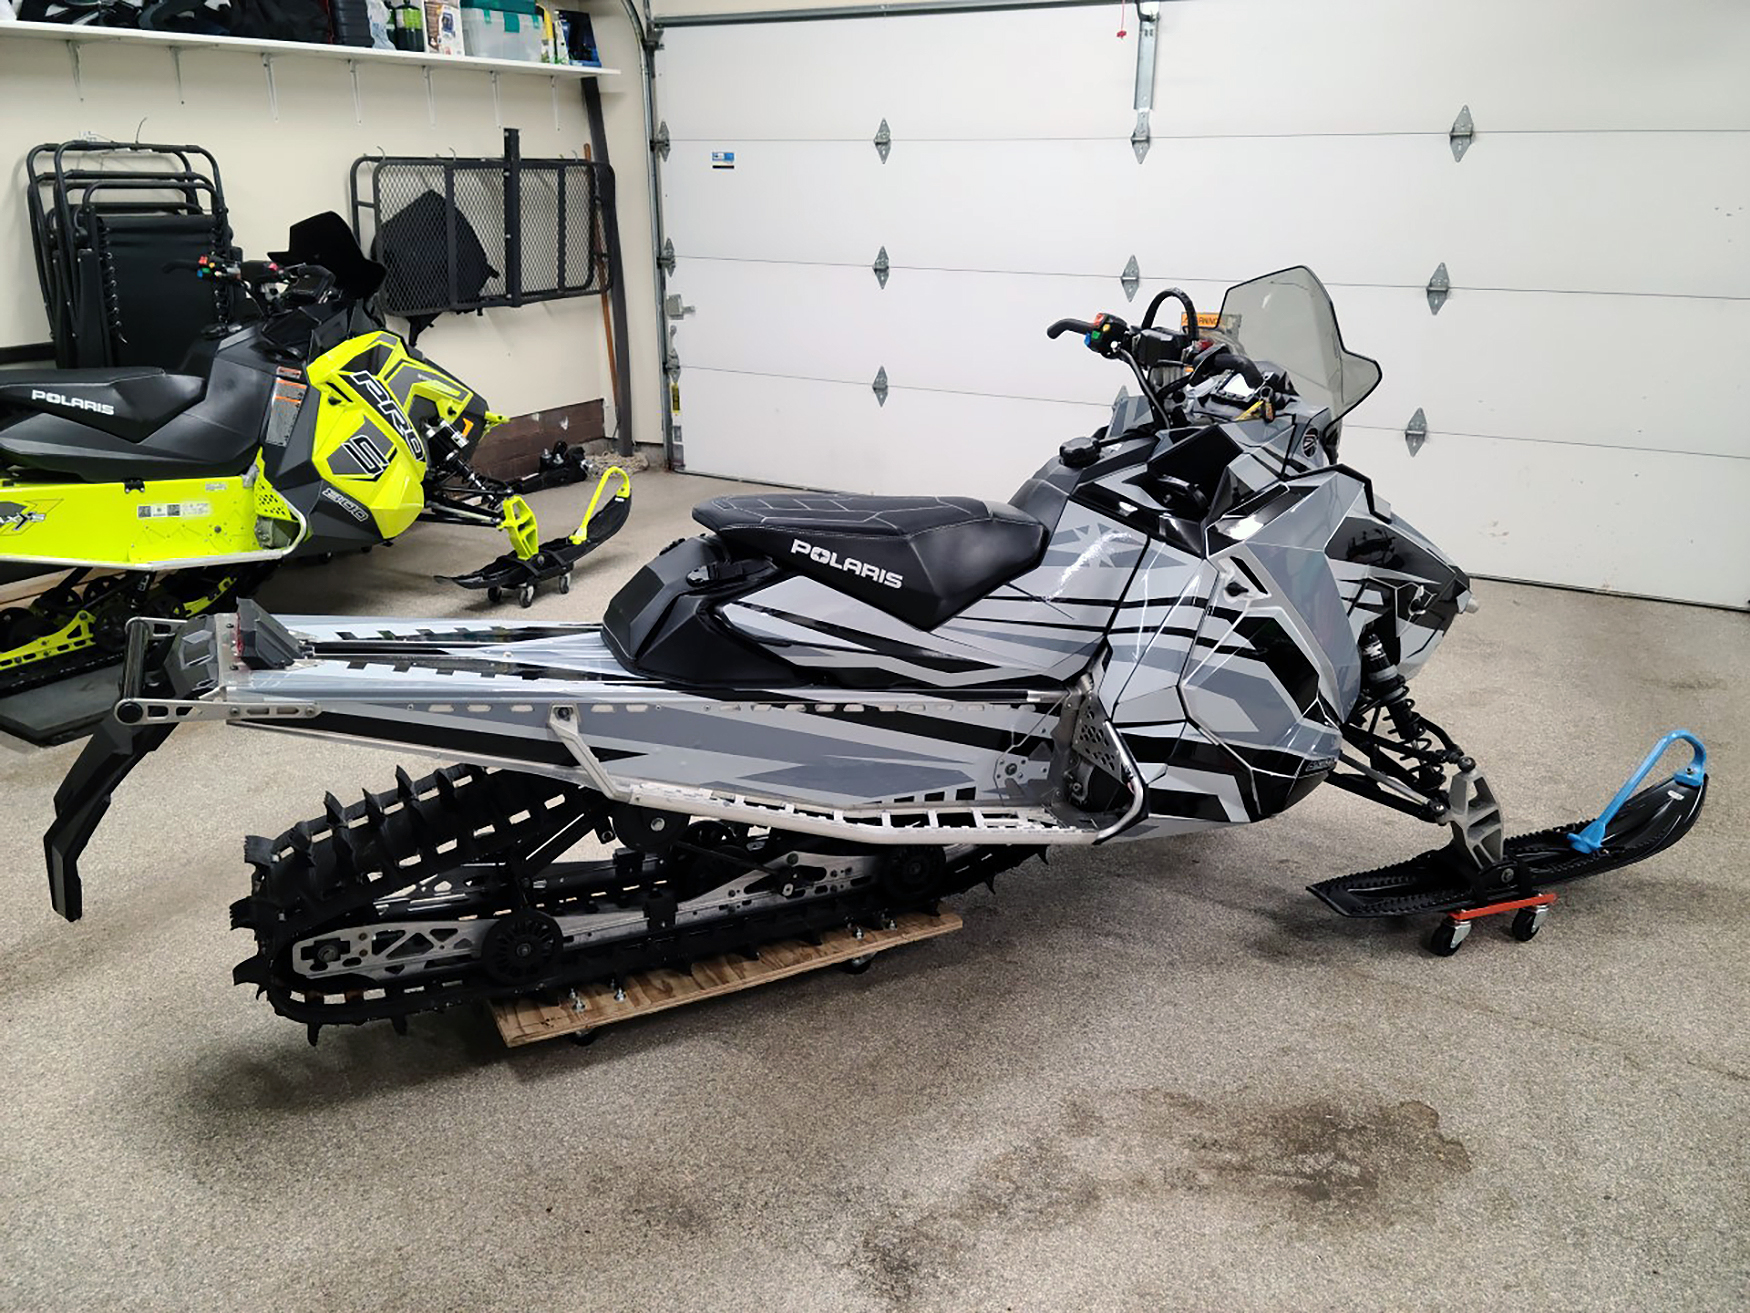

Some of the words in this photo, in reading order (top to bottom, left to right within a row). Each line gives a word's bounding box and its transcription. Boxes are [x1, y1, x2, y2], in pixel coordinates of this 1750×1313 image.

[31, 389, 115, 416] POLARIS
[350, 370, 426, 463] PRO
[321, 487, 370, 522] 800
[790, 538, 904, 589] POLARIS
